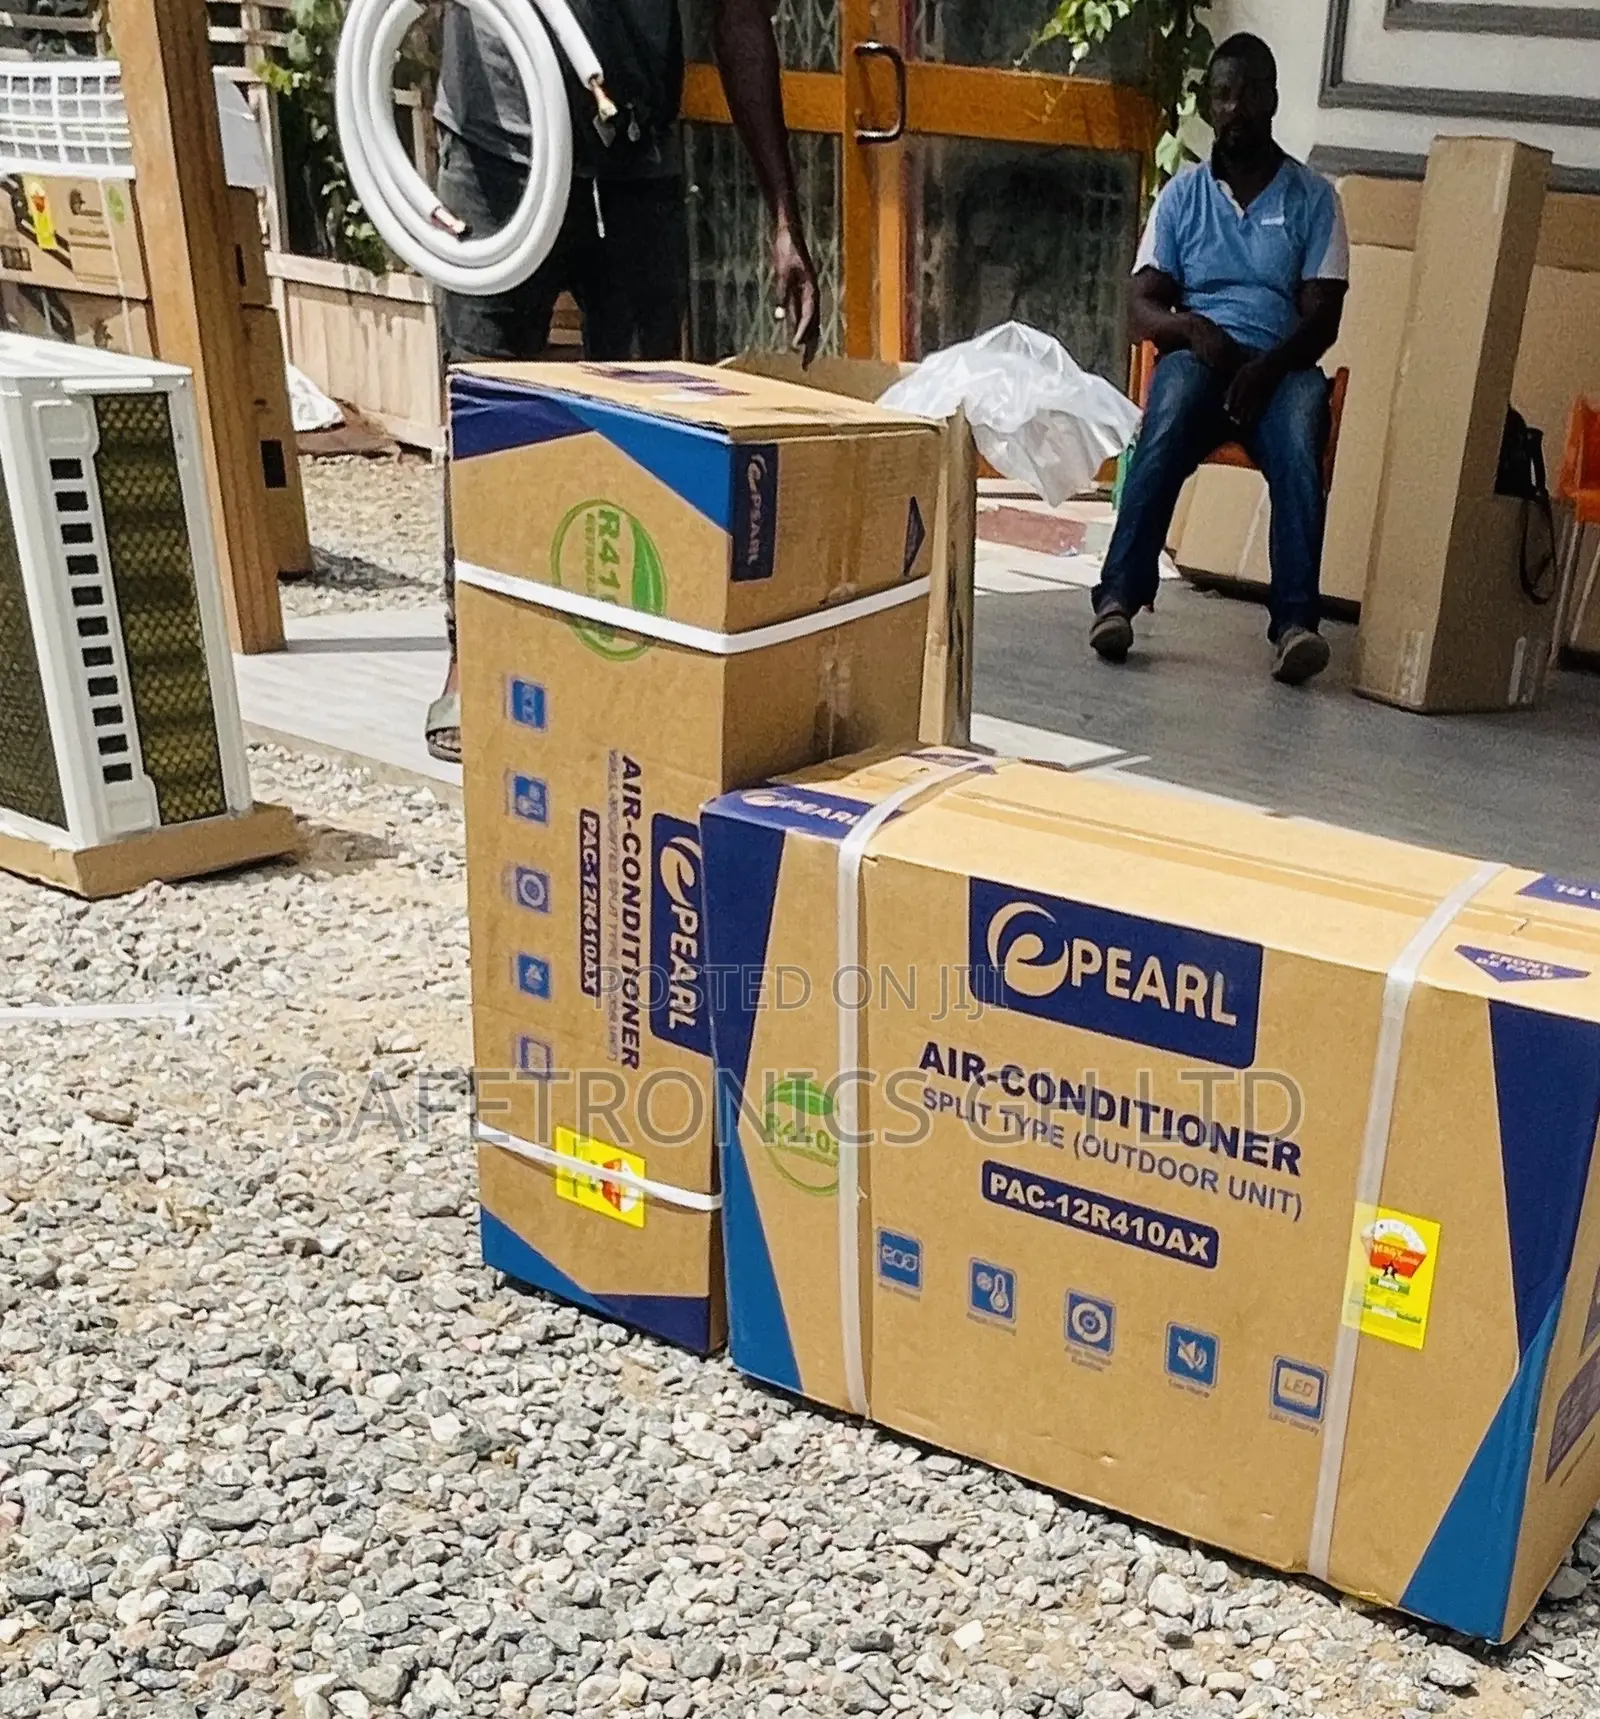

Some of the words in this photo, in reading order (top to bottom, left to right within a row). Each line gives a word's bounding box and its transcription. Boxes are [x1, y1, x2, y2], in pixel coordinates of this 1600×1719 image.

[582, 814, 598, 992] PAC-12R410AX
[621, 755, 643, 1070] AIR-CONDITIONER
[669, 903, 699, 1030] PEARL
[1070, 936, 1237, 1027] PEARL
[918, 1041, 1302, 1178] AIR-CONDITIONER
[922, 1088, 993, 1127] SPLIT
[1001, 1105, 1065, 1150] TYPE
[1073, 1131, 1219, 1194] (OUTDOOR
[1228, 1174, 1303, 1222] UNIT)
[988, 1172, 1210, 1261] PAC-12R410AX
[1283, 1376, 1316, 1398] LED
